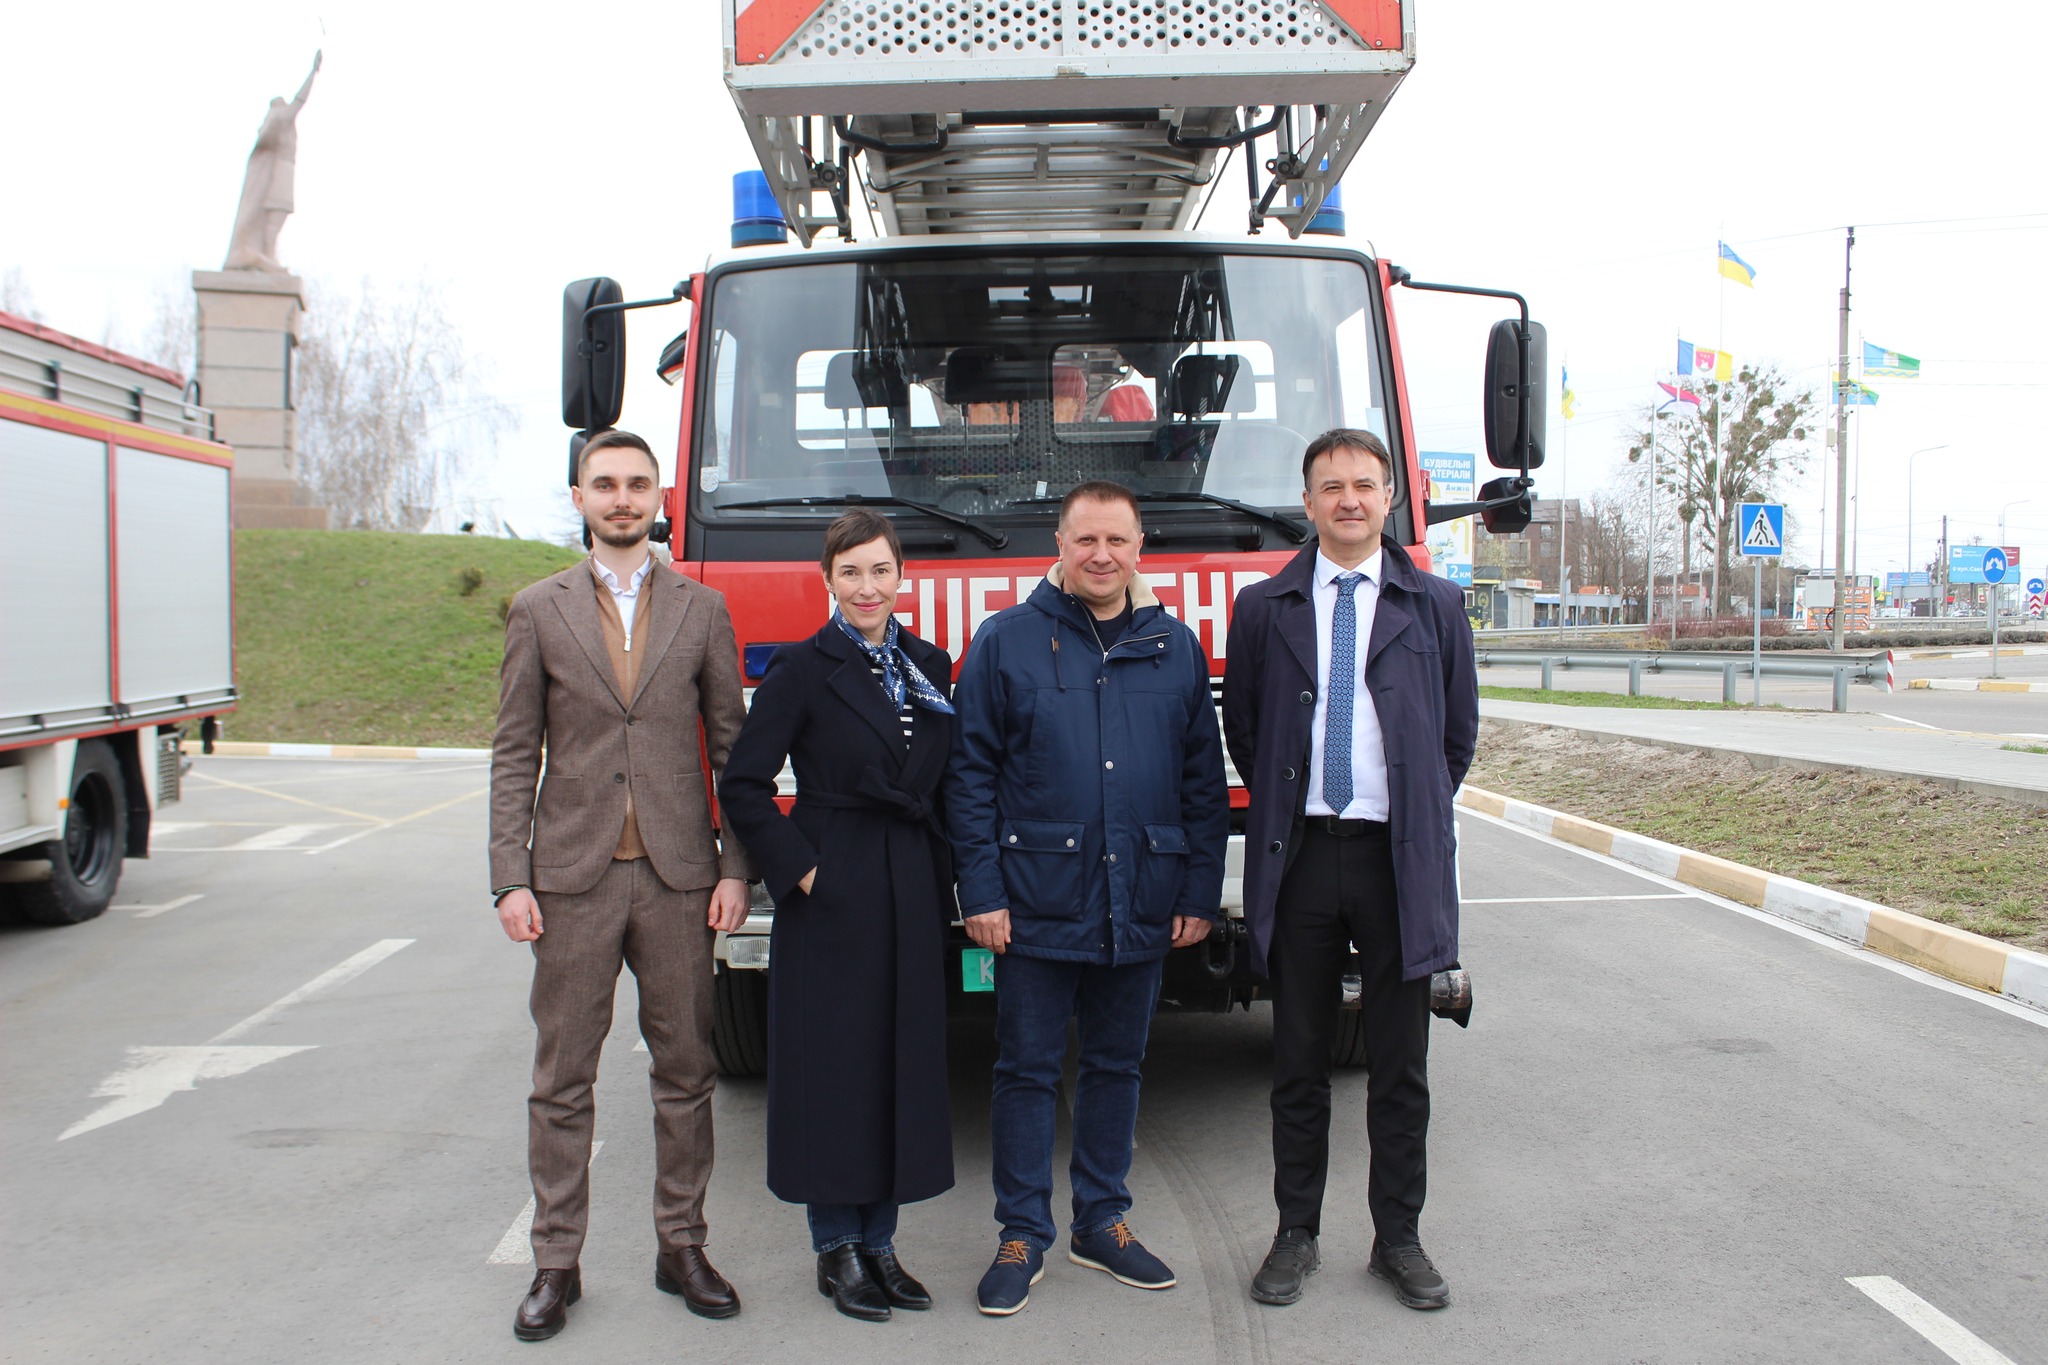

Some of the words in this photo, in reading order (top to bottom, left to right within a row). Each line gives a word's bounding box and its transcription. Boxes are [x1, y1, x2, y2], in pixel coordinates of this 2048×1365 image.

[1424, 459, 1471, 469] БУДІВЕЛЬНІ
[1426, 469, 1471, 479] АТЕРІАЛИ
[1450, 565, 1459, 579] 2
